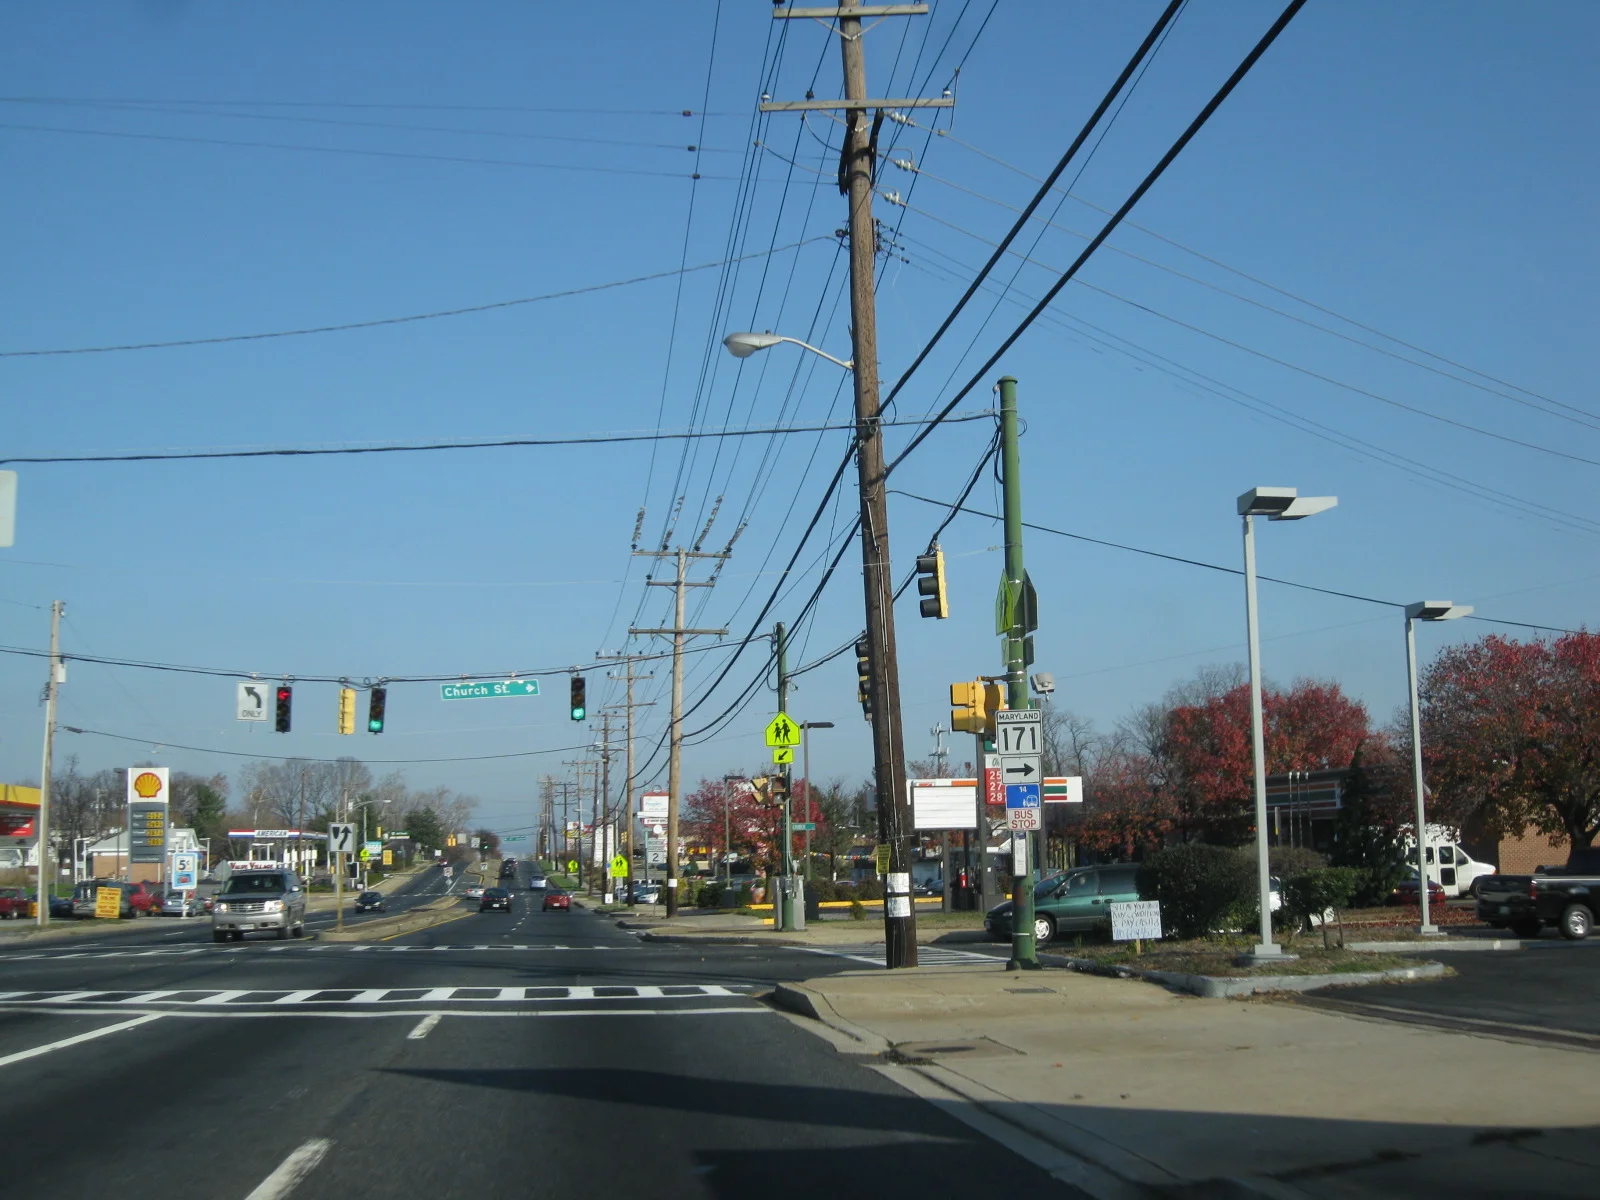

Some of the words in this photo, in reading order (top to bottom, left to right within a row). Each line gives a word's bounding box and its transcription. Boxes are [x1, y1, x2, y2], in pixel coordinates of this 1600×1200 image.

[444, 686, 488, 697] Church
[242, 709, 262, 718] ONLY
[1002, 727, 1036, 751] 171
[989, 770, 1002, 780] 25
[989, 781, 1003, 791] 27
[990, 792, 1003, 802] 28
[1014, 810, 1033, 819] BUS
[1011, 819, 1037, 829] STOP
[653, 853, 659, 862] 2
[249, 862, 274, 870] VILLAGE
[1121, 919, 1134, 928] PAY
